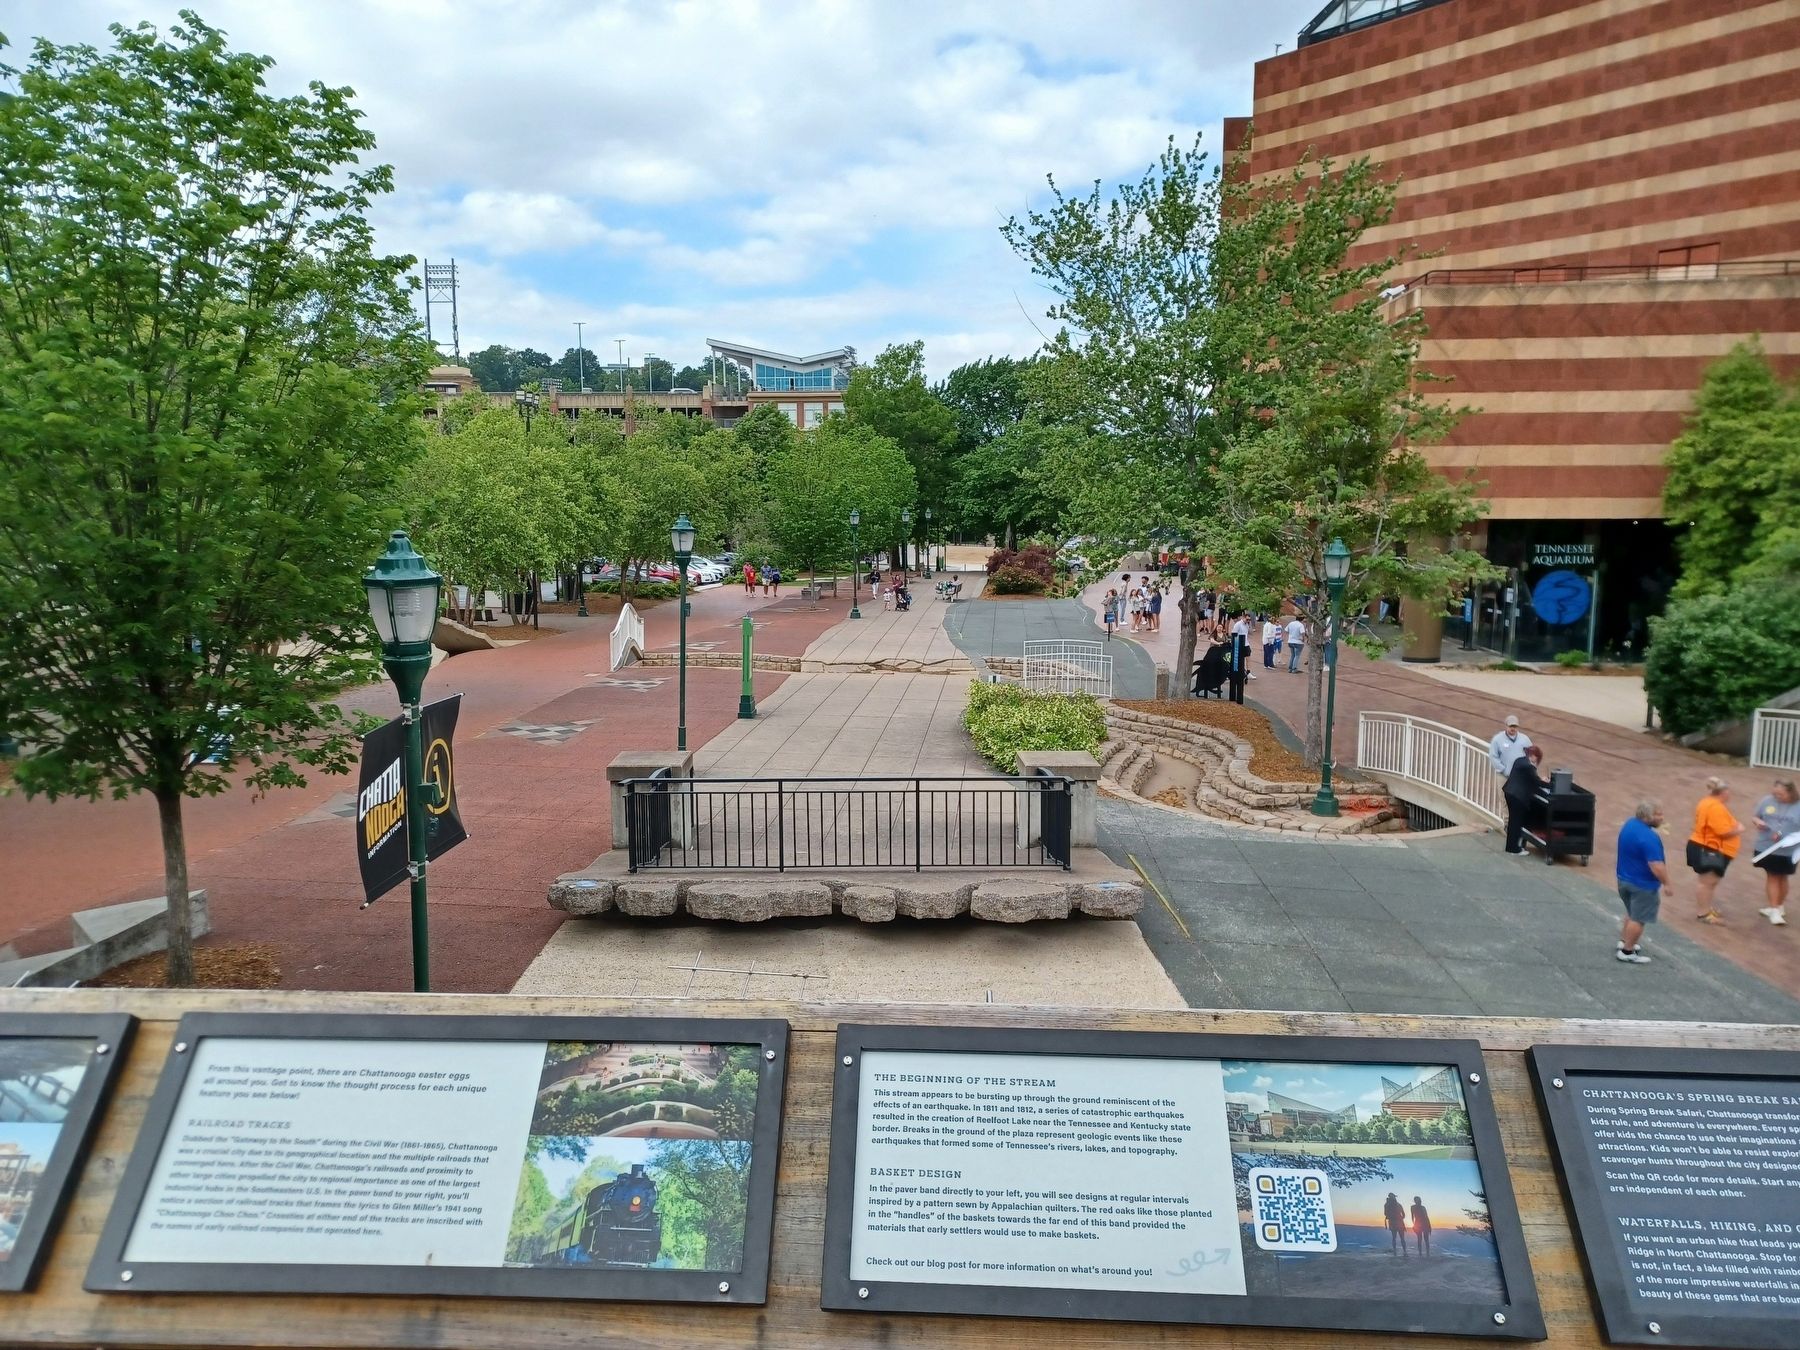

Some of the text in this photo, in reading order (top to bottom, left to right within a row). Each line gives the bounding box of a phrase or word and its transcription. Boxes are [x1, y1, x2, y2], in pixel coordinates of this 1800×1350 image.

[1535, 544, 1594, 554] TENNESSEE
[1533, 555, 1594, 566] AQUARIUM
[360, 757, 400, 821] CHATTA
[366, 786, 404, 849] NOOGA
[367, 820, 402, 859] INFORMATION
[359, 1068, 416, 1080] Chattanooga
[418, 1071, 447, 1079] easter
[448, 1073, 470, 1081] eggs
[874, 1073, 1056, 1087] THE BEGINNING OF THE STREAM
[343, 1081, 379, 1091] thought
[379, 1083, 416, 1091] process
[418, 1082, 431, 1091] for
[432, 1083, 454, 1092] each
[456, 1084, 487, 1094] unique
[874, 1088, 891, 1096] This
[921, 1091, 953, 1099] appears
[977, 1092, 1010, 1102] bursting
[1012, 1095, 1022, 1103] up
[1024, 1094, 1055, 1104] through
[1057, 1095, 1071, 1103] the
[1072, 1096, 1101, 1105] ground
[1103, 1097, 1150, 1106] reminiscent
[1152, 1098, 1160, 1106] of
[1162, 1099, 1176, 1107] the
[1583, 1089, 1684, 1101] CHATTANOOGA'S
[1687, 1093, 1734, 1103] SPRING
[1737, 1095, 1780, 1104] BREAK
[1587, 1105, 1764, 1121] During Spring Break Safari, Chattanooga
[872, 1112, 905, 1120] resulted
[907, 1113, 915, 1121] in
[916, 1113, 930, 1121] the
[931, 1114, 964, 1123] creation
[966, 1115, 974, 1123] of
[976, 1116, 1010, 1124] Reelfoot
[1011, 1117, 1031, 1125] Lake
[1053, 1118, 1066, 1127] the
[1067, 1119, 1111, 1128] Tennessee
[1113, 1121, 1128, 1129] and
[1130, 1121, 1169, 1132] Kentucky
[1594, 1129, 1615, 1138] offer
[1616, 1130, 1636, 1139] kids
[1637, 1131, 1652, 1140] the
[1654, 1132, 1686, 1141] chance
[1715, 1134, 1737, 1143] their
[1738, 1135, 1797, 1146] imaginations
[871, 1136, 921, 1146] earthquakes
[923, 1138, 939, 1146] that
[941, 1138, 970, 1147] formed
[995, 1140, 1004, 1148] of
[1005, 1141, 1055, 1151] Tennessee's
[1057, 1143, 1083, 1152] rivers,
[1085, 1144, 1109, 1153] lakes,
[1110, 1145, 1127, 1153] and
[1128, 1146, 1178, 1157] topography.
[1598, 1143, 1770, 1157] attractions. Kids won't be able to resist
[870, 1167, 962, 1179] BASKET DESIGN
[1625, 1184, 1683, 1195] independent
[1684, 1187, 1694, 1195] of
[1695, 1188, 1718, 1196] each
[1719, 1188, 1746, 1197] other.
[868, 1196, 902, 1207] inspired
[904, 1198, 914, 1208] by
[923, 1200, 954, 1208] pattern
[955, 1201, 977, 1209] sewn
[979, 1200, 989, 1211] by
[991, 1201, 1043, 1211] Appalachian
[1044, 1203, 1080, 1213] quilters.
[1081, 1205, 1097, 1213] The
[1099, 1206, 1113, 1214] red
[1115, 1206, 1135, 1215] oaks
[1137, 1207, 1153, 1216] like
[1154, 1208, 1178, 1217] those
[1180, 1209, 1212, 1219] planted
[867, 1223, 906, 1232] materials
[908, 1224, 925, 1233] that
[927, 1225, 948, 1235] early
[949, 1226, 982, 1235] settlers
[984, 1227, 1009, 1236] would
[1028, 1229, 1037, 1237] to
[1039, 1230, 1062, 1238] make
[1063, 1230, 1099, 1240] baskets.
[1618, 1217, 1792, 1233] WATERFALLS, HIKING, AND
[866, 1256, 893, 1266] Check
[927, 1259, 946, 1270] blog
[947, 1261, 966, 1270] post
[968, 1260, 981, 1269] for
[1006, 1262, 1056, 1272] information
[1070, 1265, 1100, 1274] what's
[1101, 1267, 1132, 1275] around
[1134, 1268, 1153, 1277] you!
[1635, 1274, 1645, 1283] of
[1646, 1275, 1663, 1284] the
[1664, 1277, 1689, 1285] more
[1689, 1276, 1741, 1288] impressive
[1742, 1280, 1789, 1289] waterfalls
[1639, 1288, 1777, 1303] beauty of these gems that are
